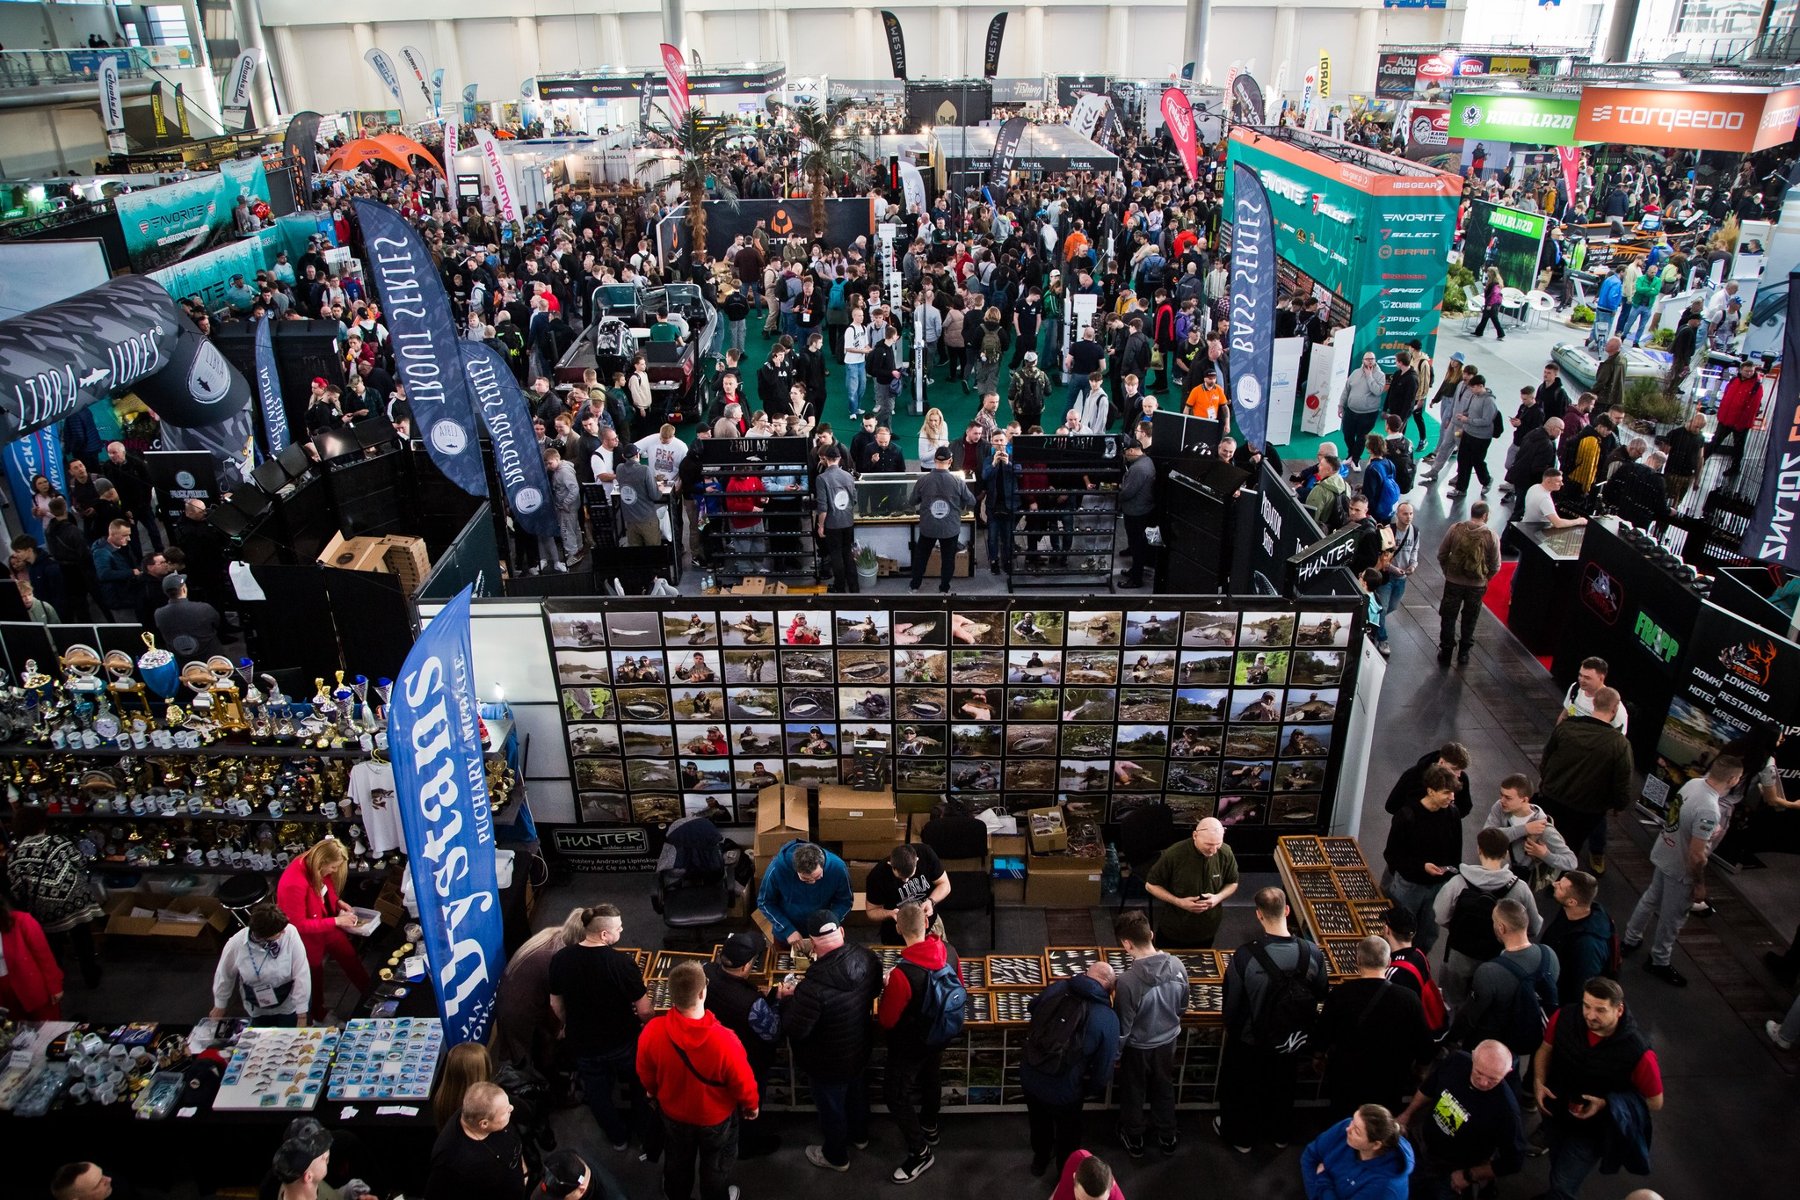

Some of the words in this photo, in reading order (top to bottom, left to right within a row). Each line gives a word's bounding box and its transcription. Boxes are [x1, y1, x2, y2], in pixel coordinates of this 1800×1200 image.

[890, 26, 905, 70] WESTIN
[986, 24, 1000, 64] WESTIN
[1384, 66, 1416, 76] Garcia
[1396, 57, 1417, 67] Abu
[1461, 65, 1482, 73] PENN
[1486, 110, 1576, 130] RAILBLAZA
[998, 138, 1019, 188] NIZEL
[1070, 159, 1092, 168] NIZEL
[151, 204, 205, 229] FAVORITE
[1382, 213, 1446, 222] FAVORITE
[1489, 210, 1534, 234] RAILBLAZA
[15, 363, 78, 431] LIBRA
[259, 366, 285, 452] AGIC/VERTICAL
[270, 396, 288, 439] SERIES
[1299, 538, 1356, 584] HUNTER
[1634, 610, 1680, 663] FRAPP
[1691, 666, 1724, 688] DOMKI
[1723, 672, 1771, 703] ŁOWISKO
[1688, 684, 1717, 706] HOTEL
[466, 758, 491, 846] PUCHARY
[404, 655, 493, 1020] Dystans
[556, 830, 645, 848] HUNTER
[459, 997, 487, 1042] JAN
